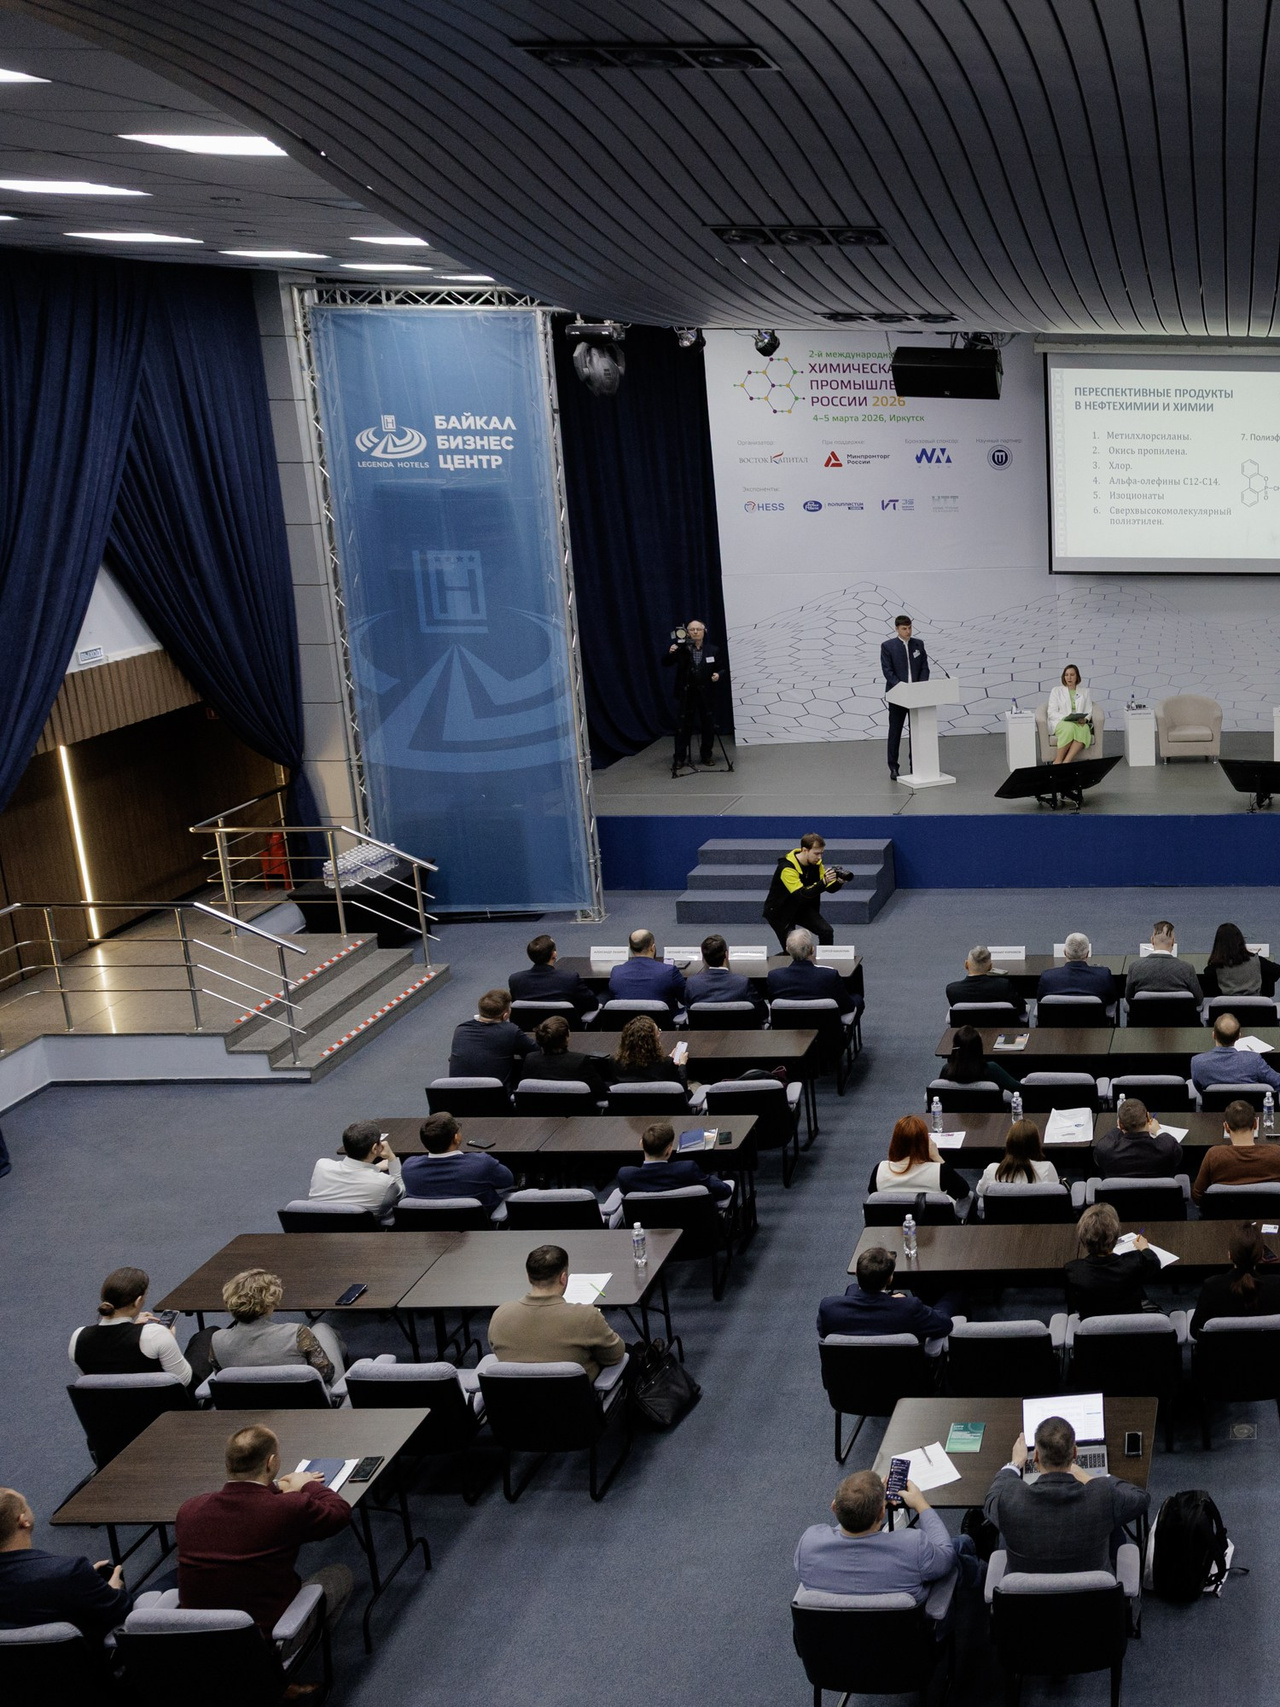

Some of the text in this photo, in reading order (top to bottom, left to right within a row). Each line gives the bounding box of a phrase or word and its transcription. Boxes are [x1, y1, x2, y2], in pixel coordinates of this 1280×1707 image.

[808, 350, 895, 359] 2-й международн
[1074, 387, 1234, 400] ПЕРЕСПЕКТИВНЫЕ ПРОДУКТЫ
[811, 396, 906, 407] РОССИИ 2026
[1075, 401, 1214, 412] В НЕФТЕХИМИИ И ХИМИИ
[434, 412, 517, 430] БАЙКАЛ
[862, 415, 887, 423] 2026,
[890, 415, 925, 423] Иркутск
[1107, 431, 1192, 442] Метилхлорсиланы.
[1241, 433, 1247, 441] 7.
[436, 435, 514, 450] БИЗНЕС
[1092, 446, 1188, 456] 2. Окись пропилена.
[438, 454, 503, 471] ЦЕНТР
[1109, 462, 1133, 471] Хлор.
[1109, 477, 1180, 487] Альфа-олефины
[1093, 491, 1165, 500] 5. Изоционаты
[758, 503, 785, 511] HESS
[1094, 506, 1232, 517] 6. Сверхвысокомолекулярный
[1110, 518, 1164, 526] полиэтилен.
